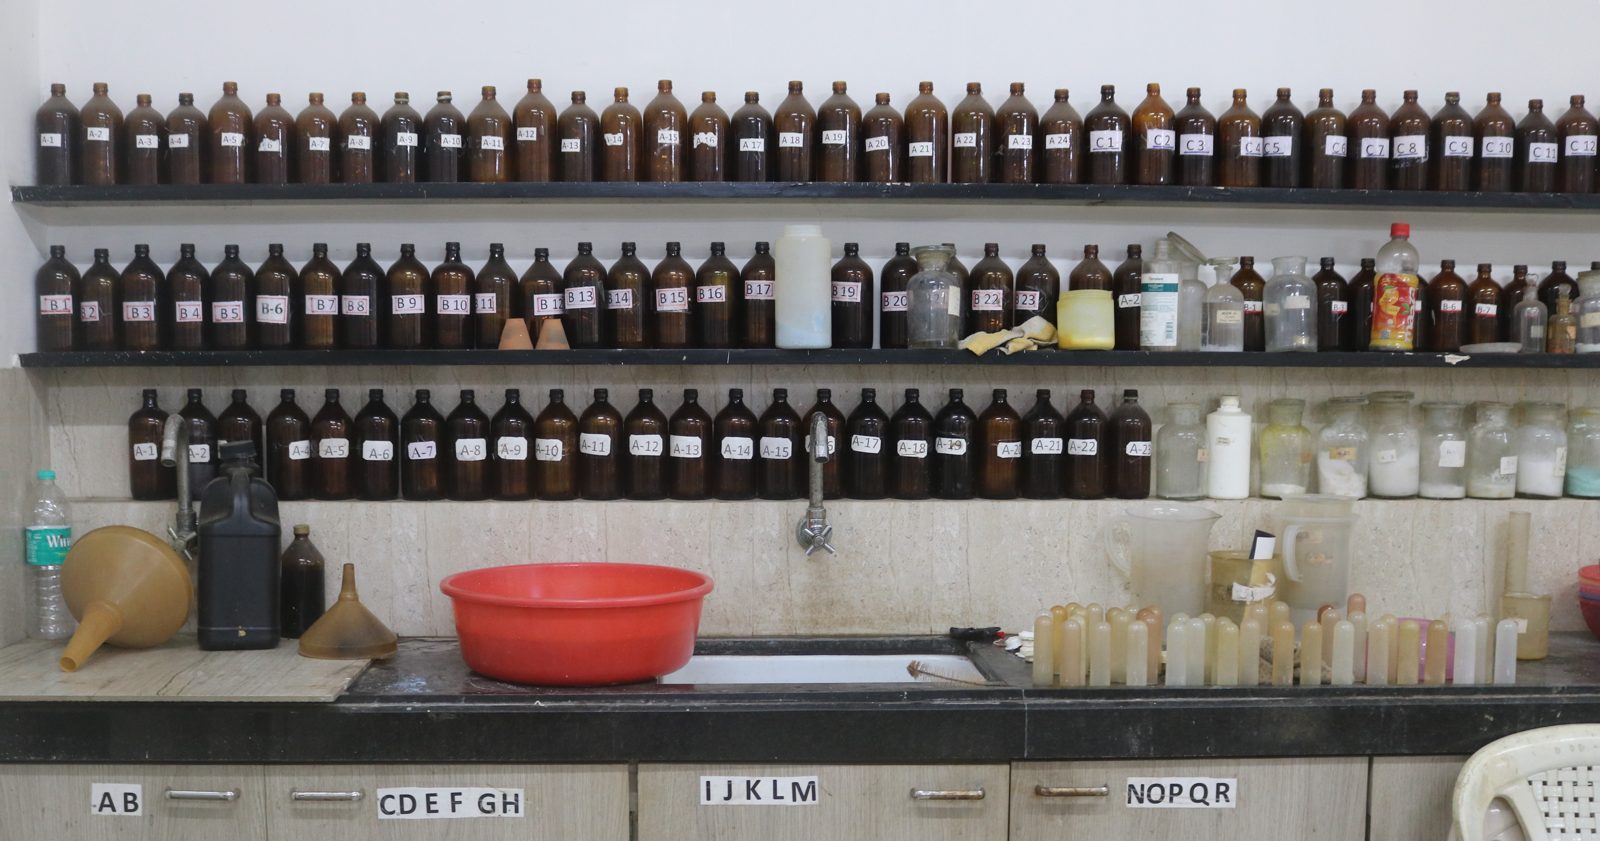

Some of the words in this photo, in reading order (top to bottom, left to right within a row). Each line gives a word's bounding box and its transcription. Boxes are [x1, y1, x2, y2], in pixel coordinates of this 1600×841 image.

[89, 130, 102, 138] A-2
[223, 135, 237, 143] A-5
[518, 130, 535, 138] A-12
[659, 133, 678, 142] A-15
[833, 133, 843, 141] 19
[42, 136, 54, 144] A-1
[138, 138, 152, 146] A-3
[170, 137, 182, 145] A-4
[311, 140, 325, 148] A-7
[349, 138, 363, 146] A-8
[399, 136, 413, 144] A-9
[442, 137, 460, 145] A-10
[483, 139, 501, 147] A-11
[562, 141, 579, 150] A-13
[751, 141, 762, 149] 17
[791, 136, 800, 144] 18
[1021, 137, 1031, 145] 23
[1057, 136, 1068, 144] 24
[1096, 137, 1104, 148] C
[1107, 137, 1114, 147] 1
[1154, 134, 1162, 145] C
[1164, 135, 1171, 146] 2
[1186, 139, 1195, 151] C
[1198, 140, 1204, 151] 3
[920, 145, 929, 153] 21
[1245, 142, 1253, 153] C
[1273, 142, 1280, 153] 5
[1332, 142, 1340, 154] C
[1366, 144, 1374, 155] C
[1378, 144, 1384, 155] 7
[1397, 142, 1405, 154] C
[1409, 142, 1416, 153] 8
[1448, 141, 1457, 152] C
[1461, 141, 1467, 152] 9
[1486, 142, 1494, 153] C
[1499, 142, 1511, 154] 10
[1570, 140, 1578, 151] C
[1583, 140, 1595, 152] 12
[1533, 147, 1541, 158] C
[1546, 147, 1556, 159] 11
[699, 288, 705, 299] B
[709, 287, 723, 299] 16
[746, 284, 752, 294] B
[757, 283, 771, 295] 17
[832, 284, 838, 295] B
[841, 285, 855, 298] 19
[568, 291, 575, 303] B
[579, 290, 593, 302] 13
[615, 292, 628, 304] 14
[659, 292, 667, 304] B
[670, 291, 685, 303] 15
[883, 296, 889, 306] B
[974, 294, 980, 305] B
[984, 293, 998, 305] 22
[1022, 293, 1036, 305] 23
[50, 300, 58, 310] B
[63, 299, 69, 310] 1
[317, 299, 324, 310] B
[328, 299, 335, 310] 7
[357, 300, 365, 312] 8
[397, 297, 404, 308] B
[409, 297, 416, 308] 9
[442, 300, 449, 310] B
[453, 299, 467, 311] 10
[481, 298, 494, 309] 11
[540, 299, 548, 310] B
[553, 298, 564, 310] 12
[89, 307, 95, 318] 2
[131, 308, 139, 318] B
[143, 308, 150, 318] 3
[181, 308, 188, 319] B
[192, 307, 199, 318] 4
[221, 308, 228, 319] B
[231, 308, 238, 319] 5
[261, 303, 283, 314] B-6
[581, 439, 605, 452] A-11
[631, 439, 659, 452] A-12
[852, 435, 879, 449] A-17
[936, 438, 962, 450] A-19
[1034, 439, 1060, 451] A-21
[1069, 441, 1096, 452] A-22
[135, 445, 155, 456] A-1
[189, 447, 207, 459] A-2
[325, 444, 345, 456] A-5
[369, 448, 390, 459] A-6
[411, 445, 433, 458] A-7
[460, 444, 480, 455] A-8
[500, 444, 521, 455] A-9
[535, 443, 558, 456] A-10
[673, 443, 699, 456] A-13
[723, 443, 751, 456] A-14
[762, 445, 789, 458] A-15
[899, 443, 926, 454] A-18
